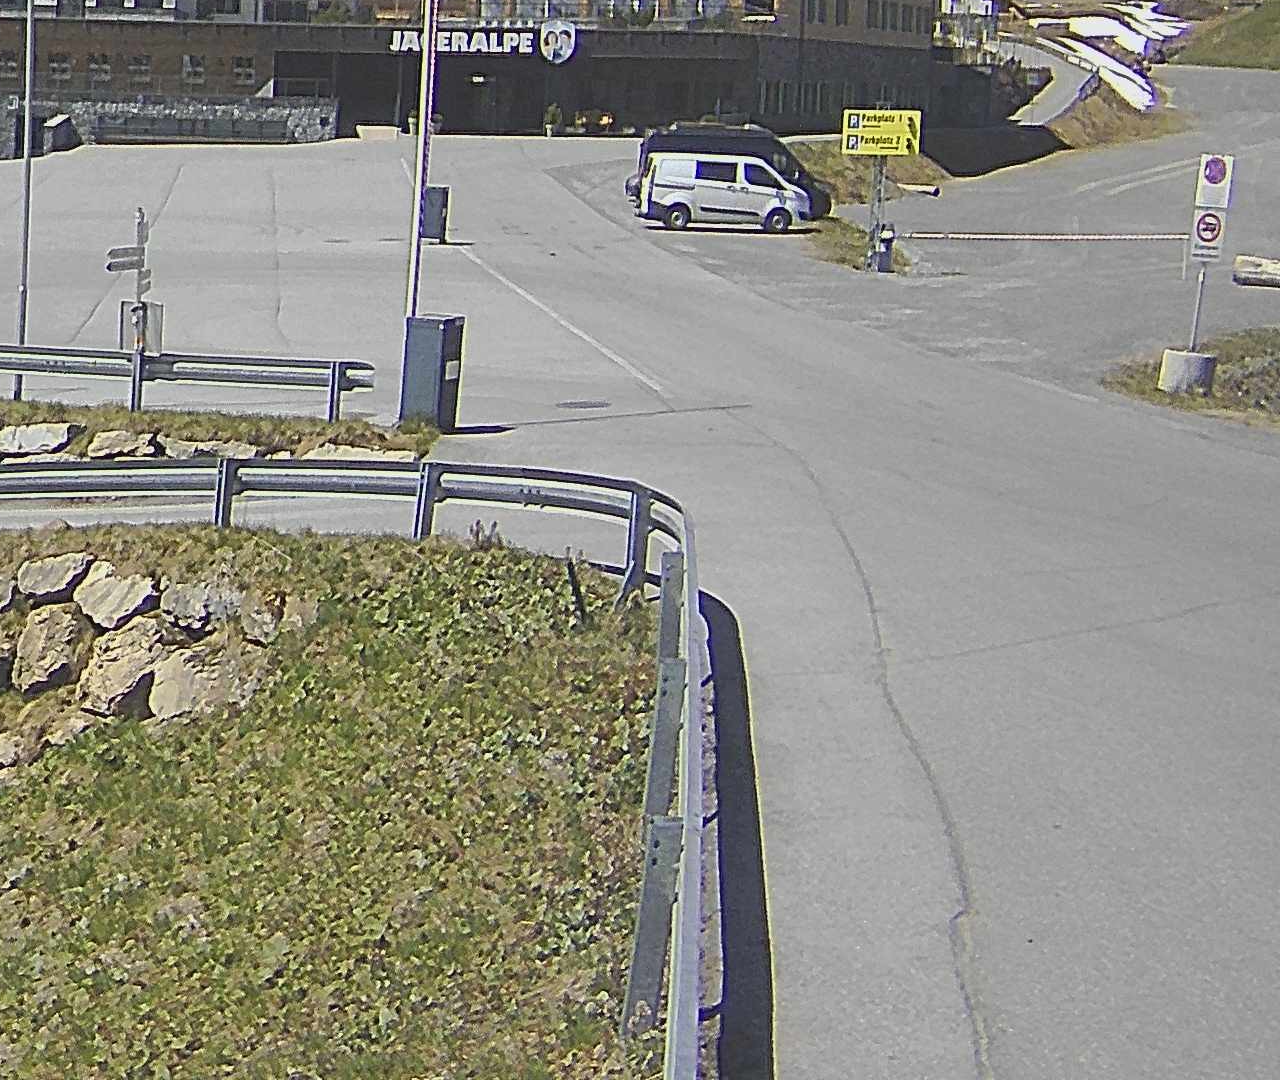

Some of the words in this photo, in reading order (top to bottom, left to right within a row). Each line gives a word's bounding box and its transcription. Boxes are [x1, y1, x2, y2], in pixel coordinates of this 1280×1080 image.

[390, 30, 534, 53] JÄERALPE
[862, 114, 895, 123] Parkplatz
[861, 136, 893, 146] Parkplatz
